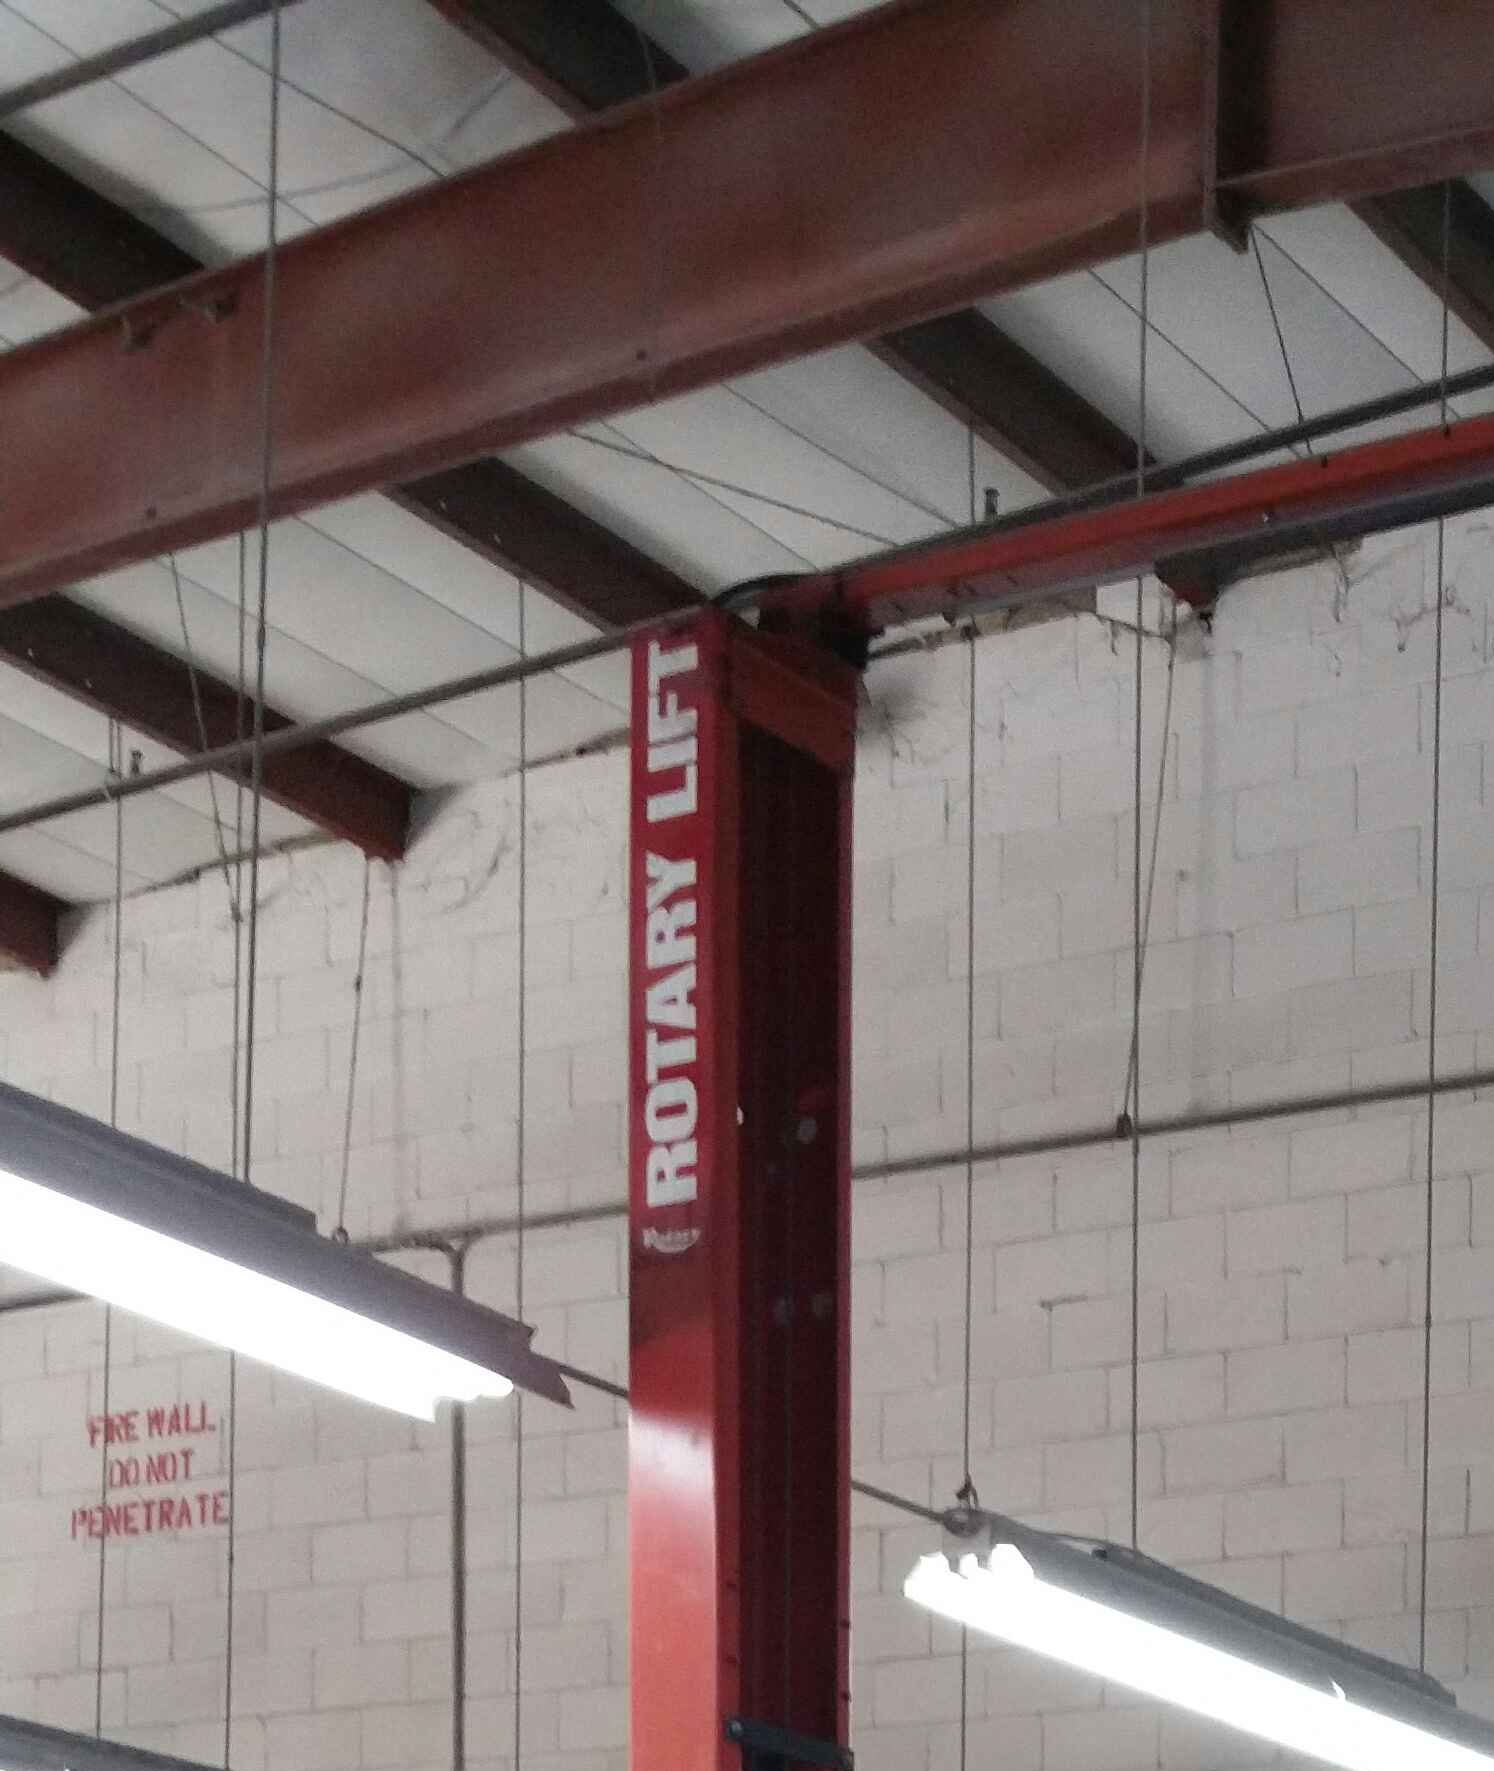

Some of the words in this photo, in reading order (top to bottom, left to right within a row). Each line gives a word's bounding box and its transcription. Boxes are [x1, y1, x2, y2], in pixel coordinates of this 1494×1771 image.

[646, 641, 699, 823] LIFT
[644, 853, 698, 1208] ROTARY
[87, 1410, 140, 1448] FIRE
[147, 1400, 217, 1439] WALL
[108, 1455, 140, 1490] DO
[146, 1447, 196, 1485] NOT
[71, 1490, 231, 1541] PENETRATE
